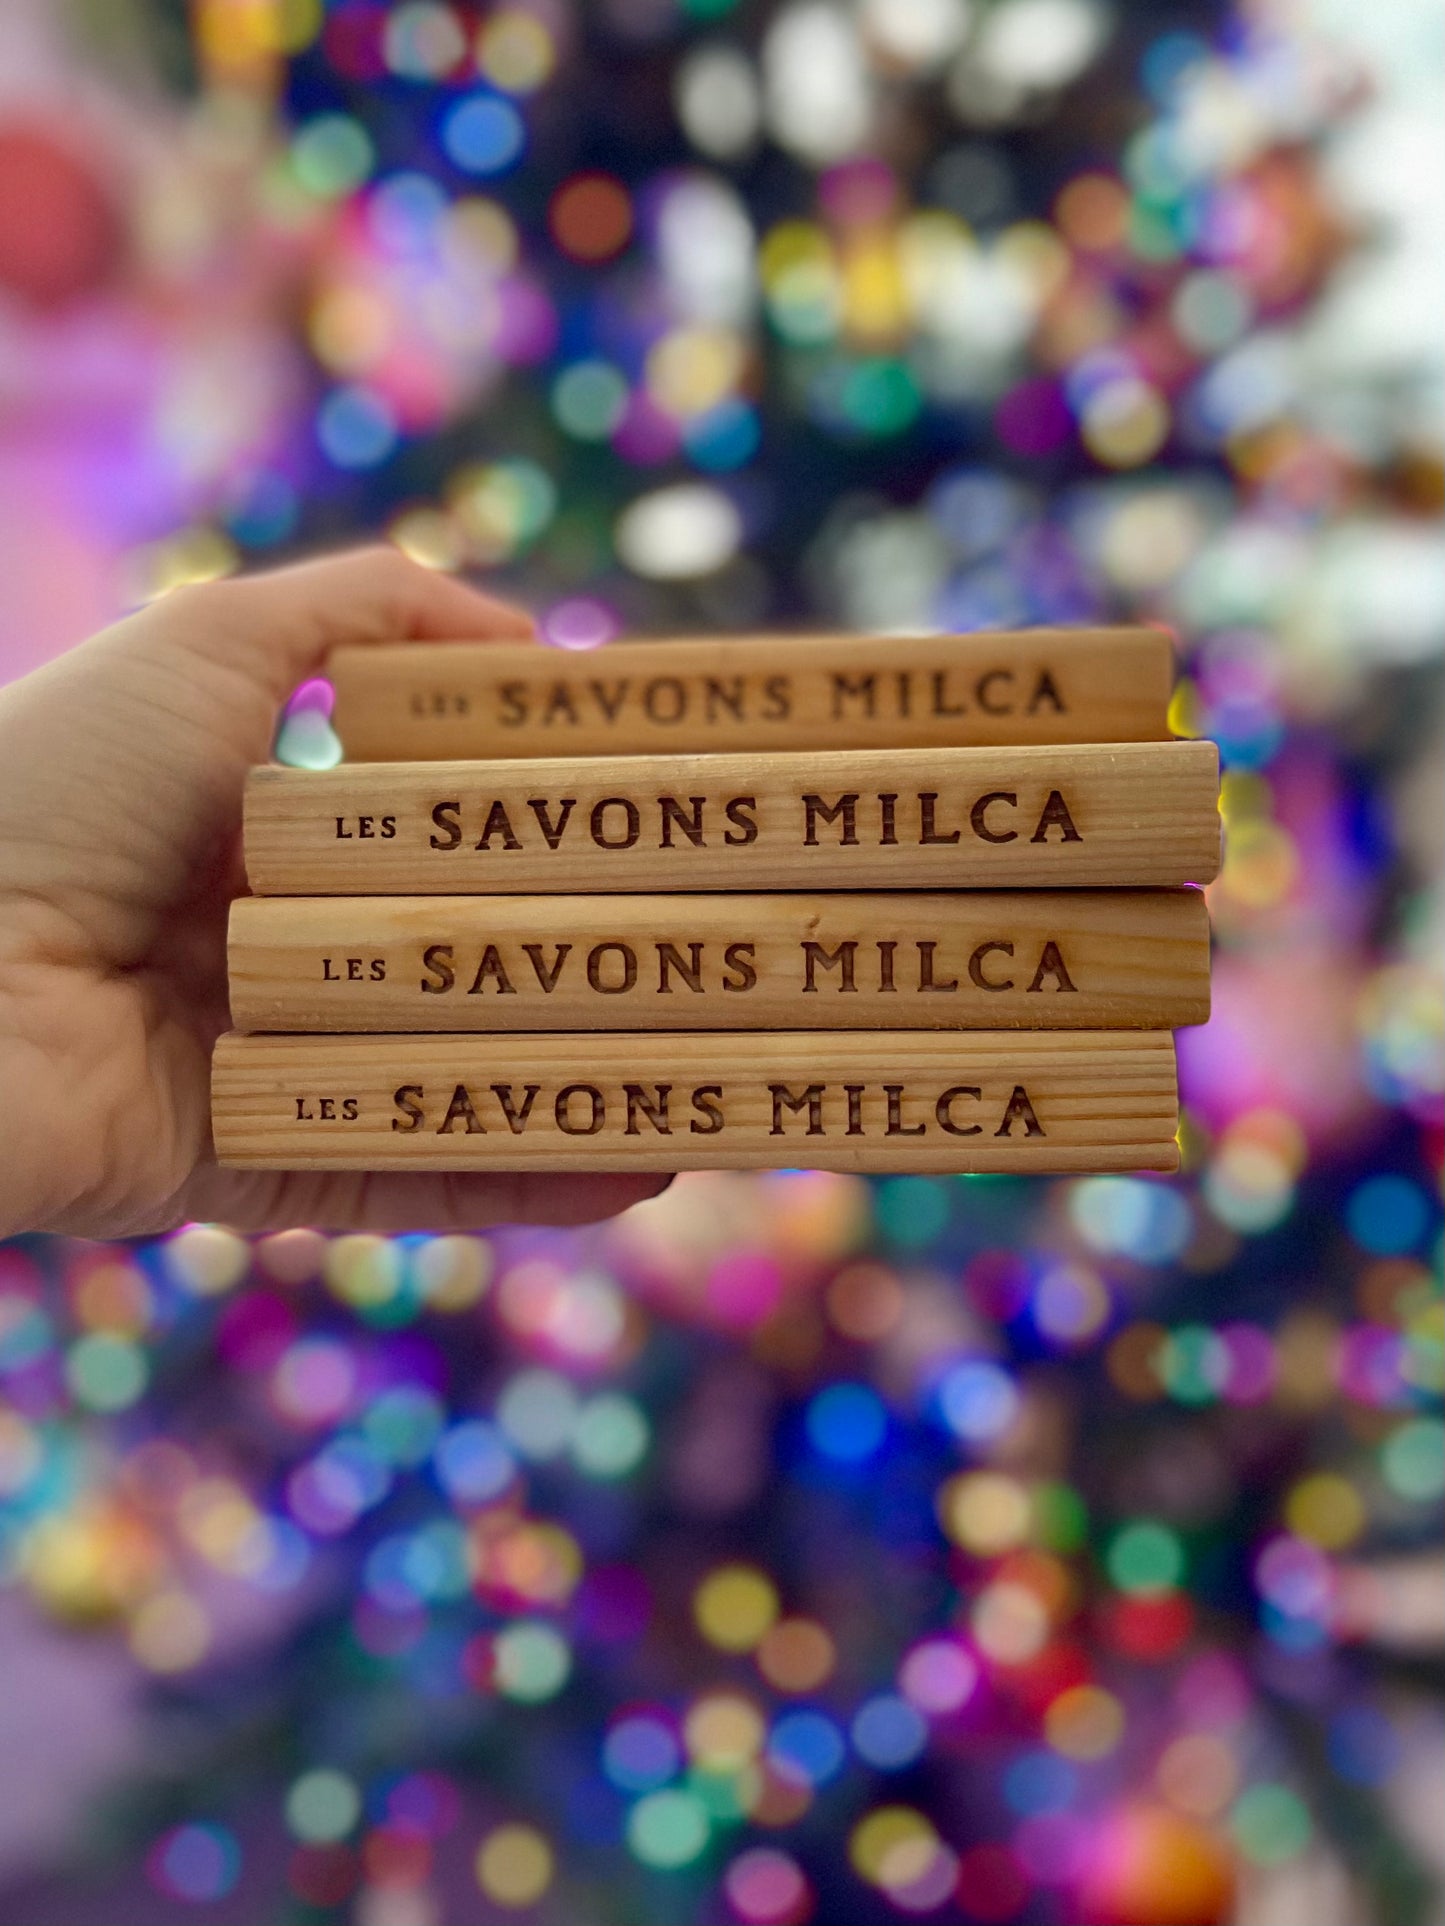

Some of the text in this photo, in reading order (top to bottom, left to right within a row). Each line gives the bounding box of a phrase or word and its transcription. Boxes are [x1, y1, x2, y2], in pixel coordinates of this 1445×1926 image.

[497, 674, 794, 728] SAVONS
[830, 669, 1068, 720] MILCA
[335, 790, 1083, 851] LES SAVONS MILCA
[322, 941, 1078, 995] LES SAVONS MILCA
[296, 1084, 1046, 1137] LES SAVONS MILCA
